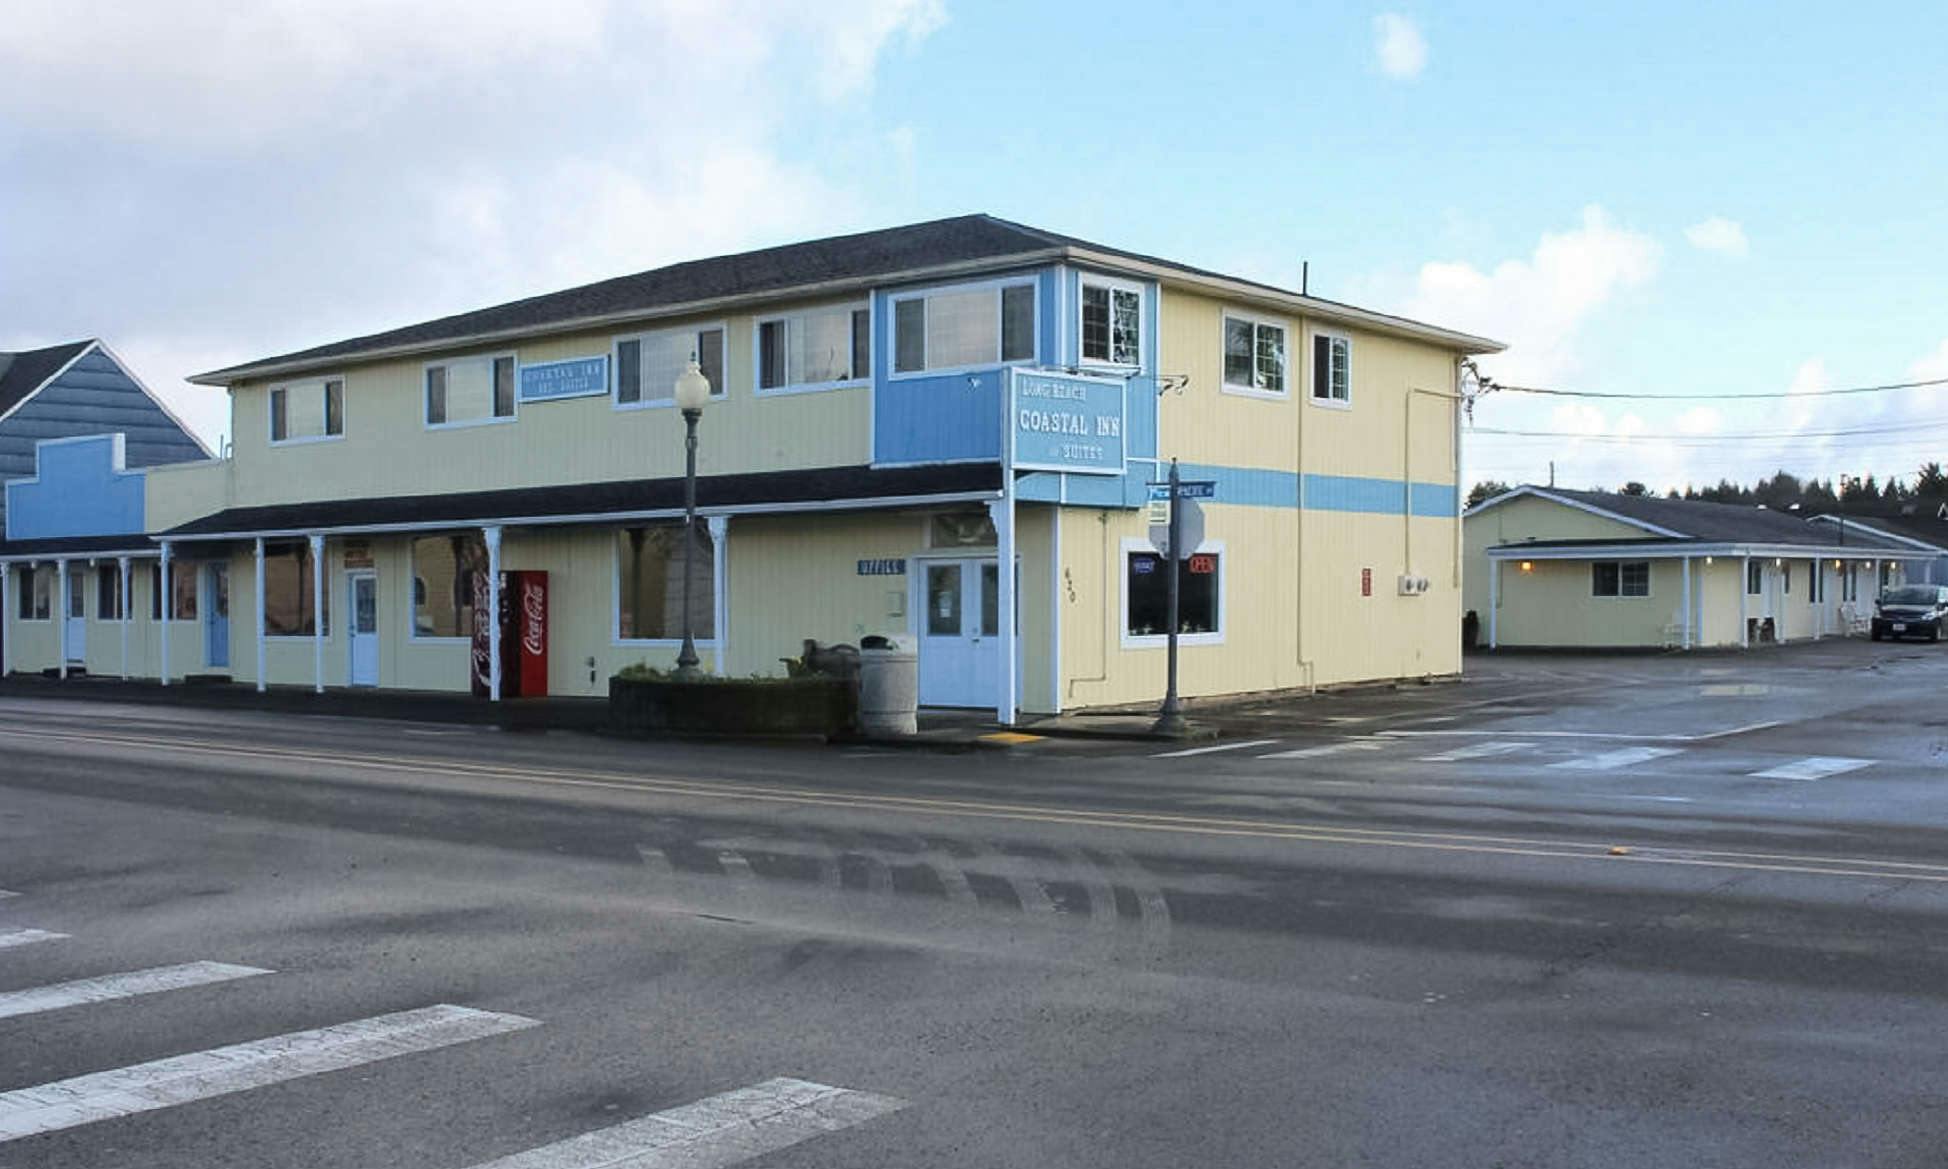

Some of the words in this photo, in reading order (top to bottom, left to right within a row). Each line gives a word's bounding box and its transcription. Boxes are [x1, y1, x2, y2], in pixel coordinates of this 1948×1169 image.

[1022, 377, 1050, 397] LONG
[1053, 383, 1086, 400] BEACH
[1020, 410, 1088, 435] COASTAL
[1096, 416, 1121, 437] INN
[1063, 445, 1103, 460] SUITES
[1189, 556, 1216, 574] OPEN
[523, 580, 544, 655] Coca-Cola
